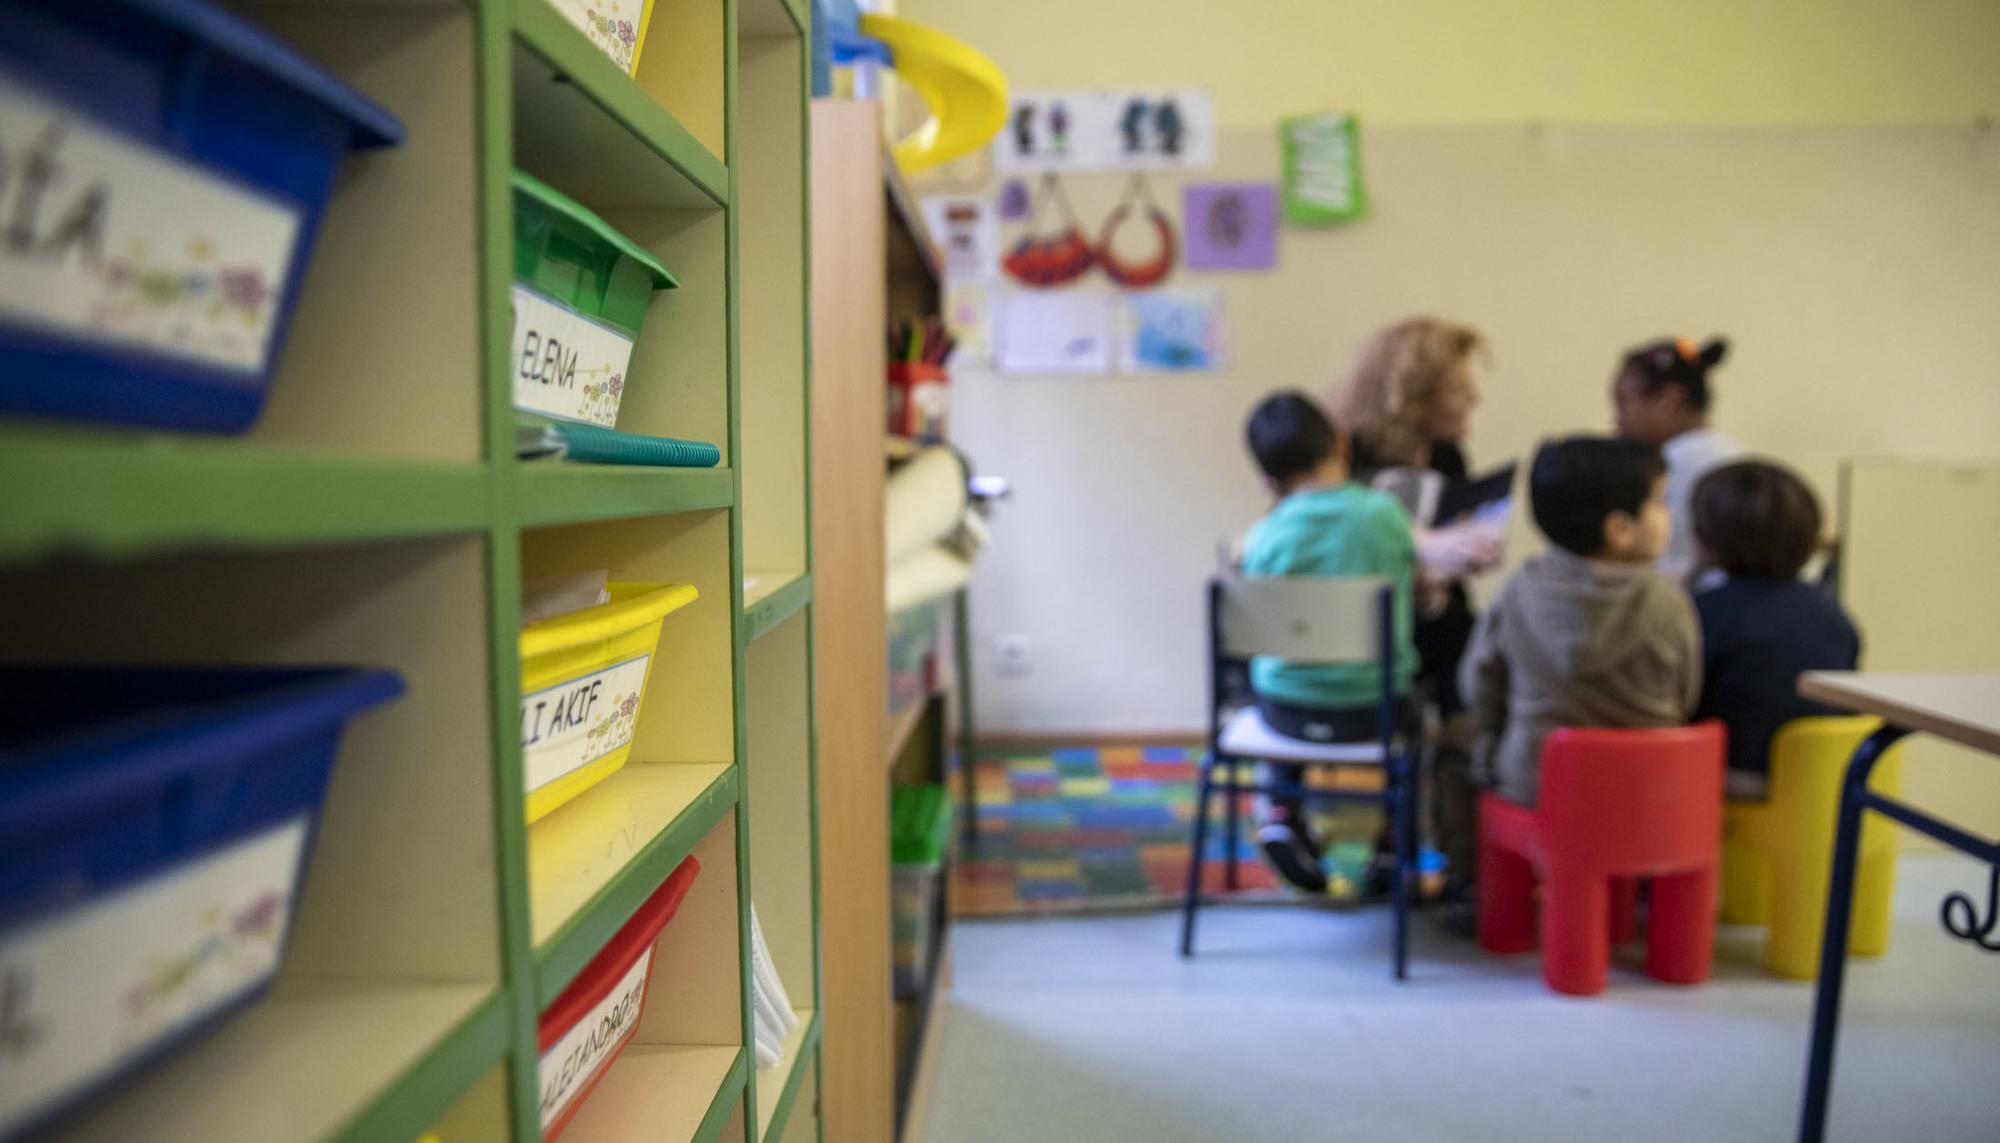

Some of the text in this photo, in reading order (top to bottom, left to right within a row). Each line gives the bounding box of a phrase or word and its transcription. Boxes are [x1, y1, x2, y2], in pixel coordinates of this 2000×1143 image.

[0, 115, 108, 268] ÍA
[521, 330, 578, 389] ELENA
[549, 680, 602, 737] AKIF
[537, 993, 630, 1115] ALEJANDRO
